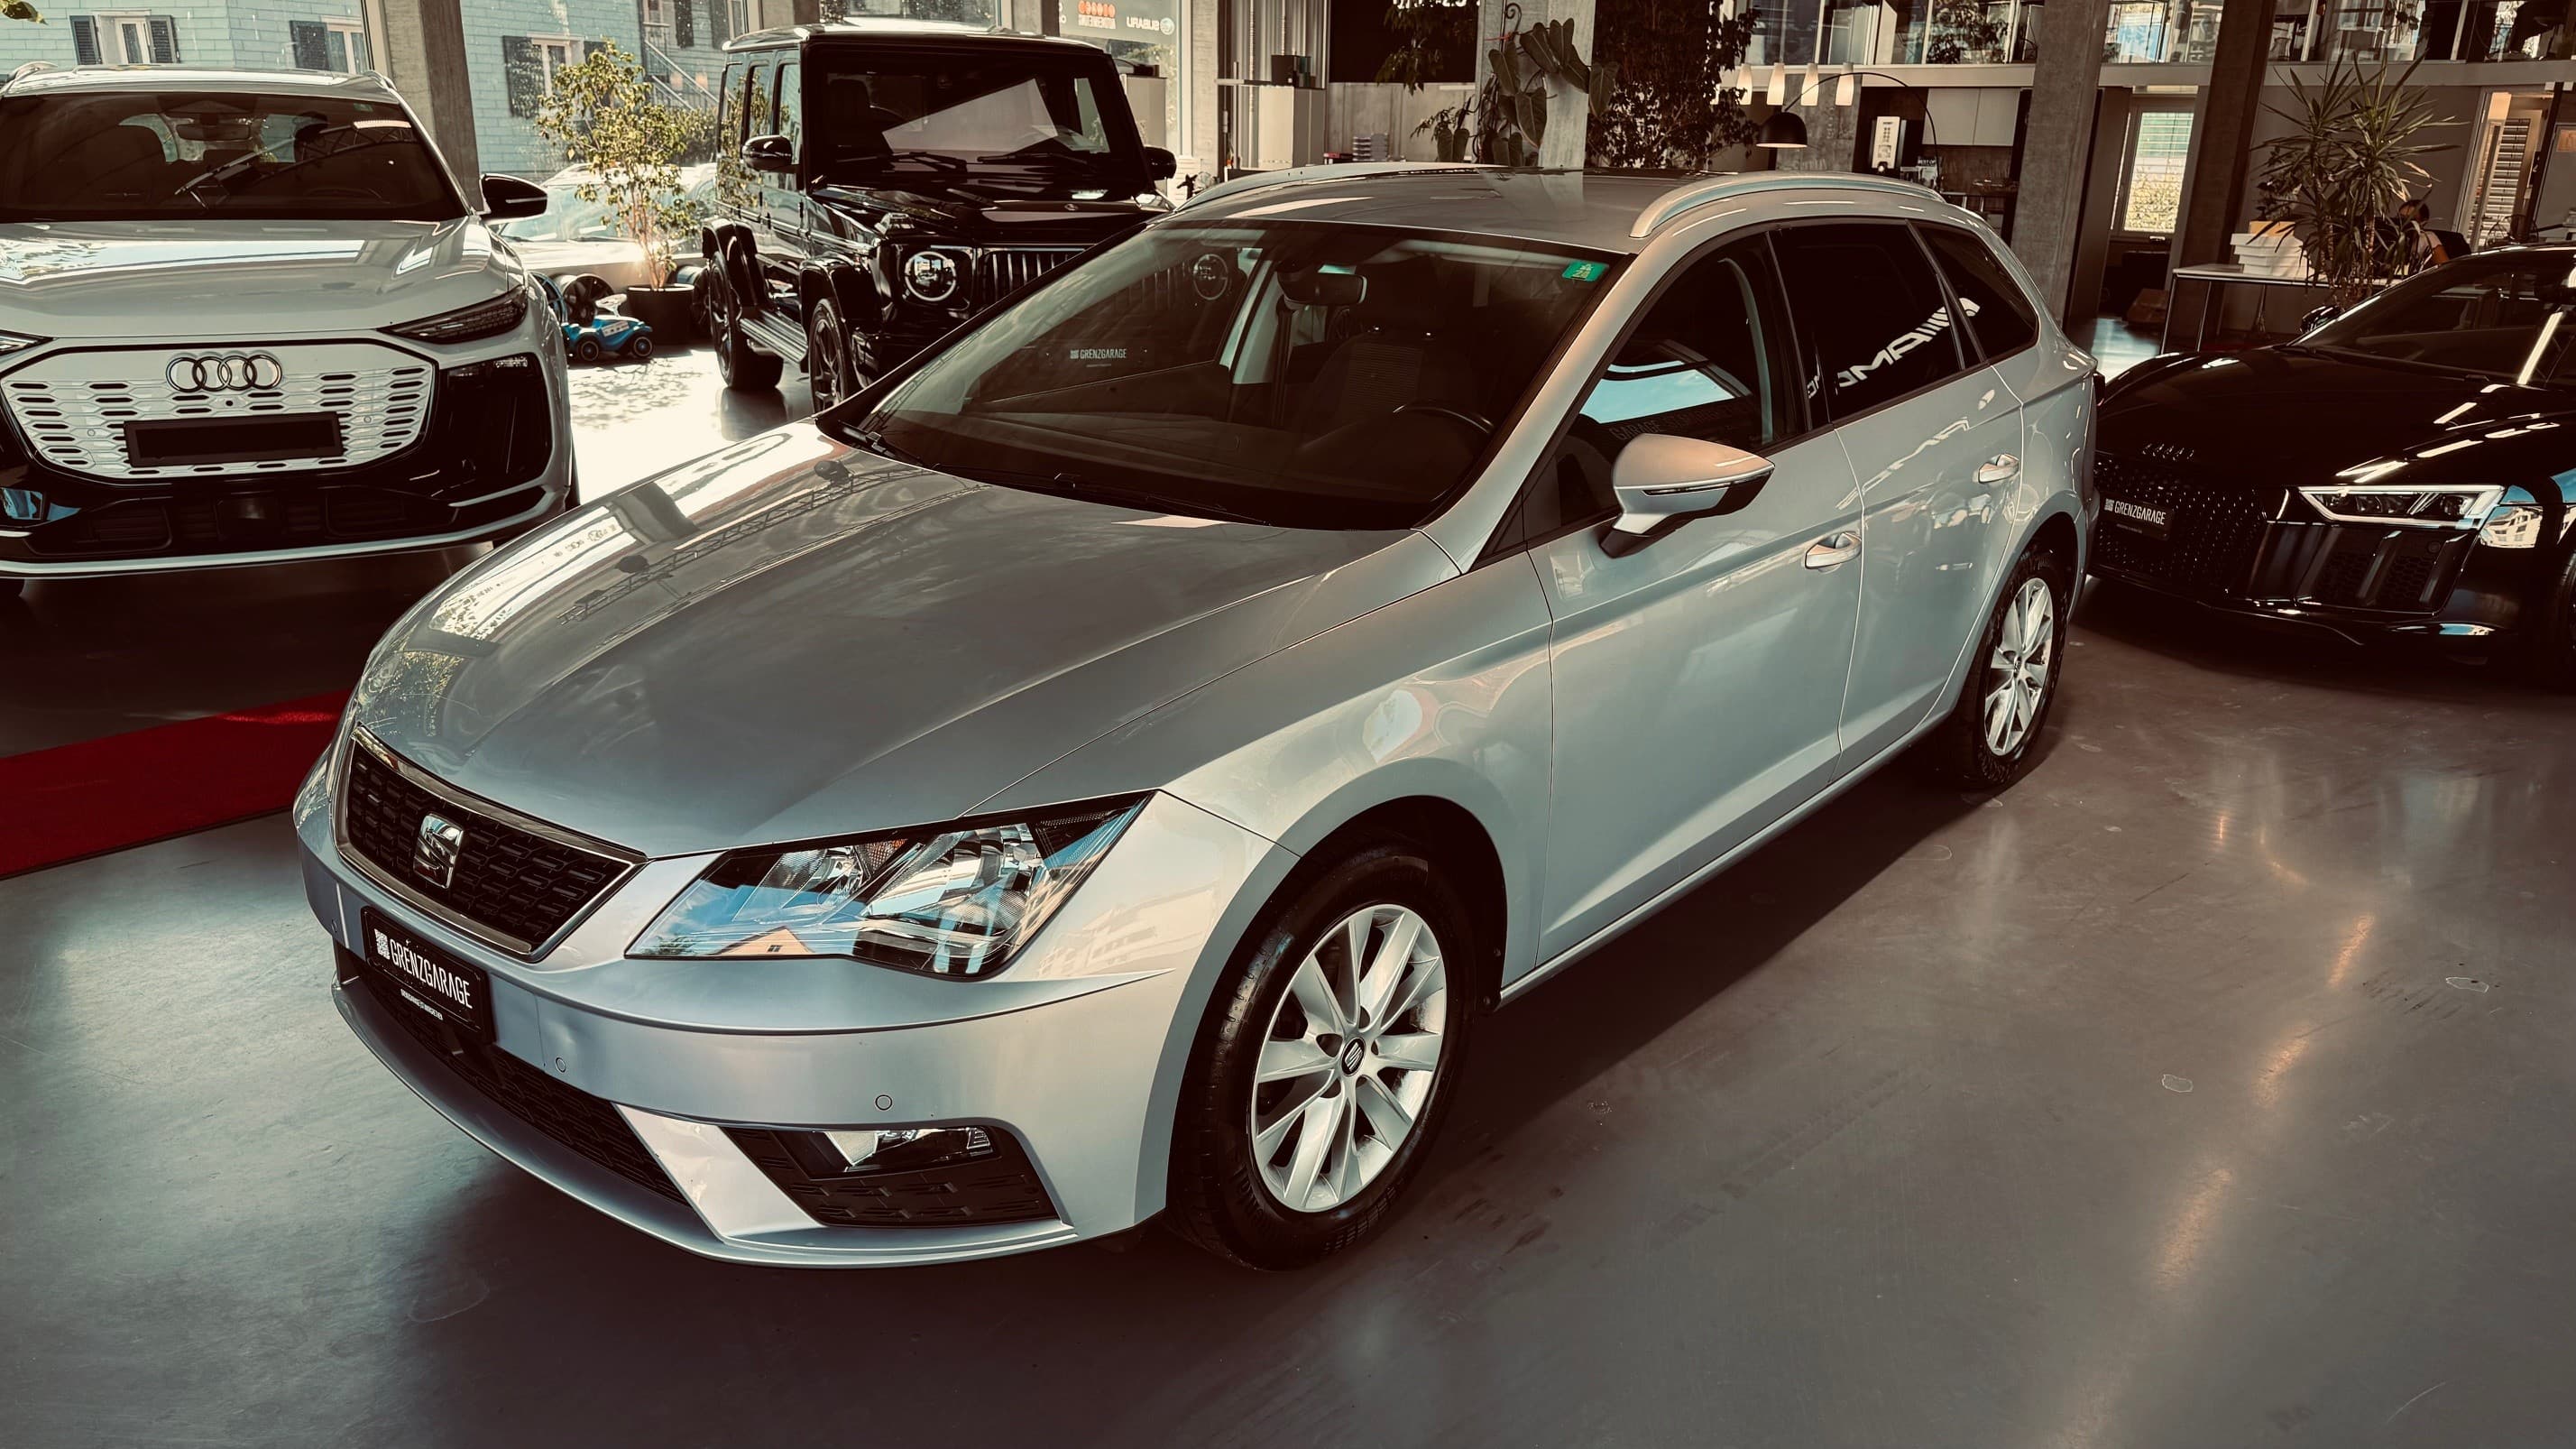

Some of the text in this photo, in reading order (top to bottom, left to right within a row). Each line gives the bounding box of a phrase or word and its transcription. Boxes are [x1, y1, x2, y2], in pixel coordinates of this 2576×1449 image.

[1080, 348, 1127, 359] GRENZGARAGE
[2114, 501, 2167, 526] GRENZGARAGE
[390, 938, 474, 1010] GRENZGARAGE
